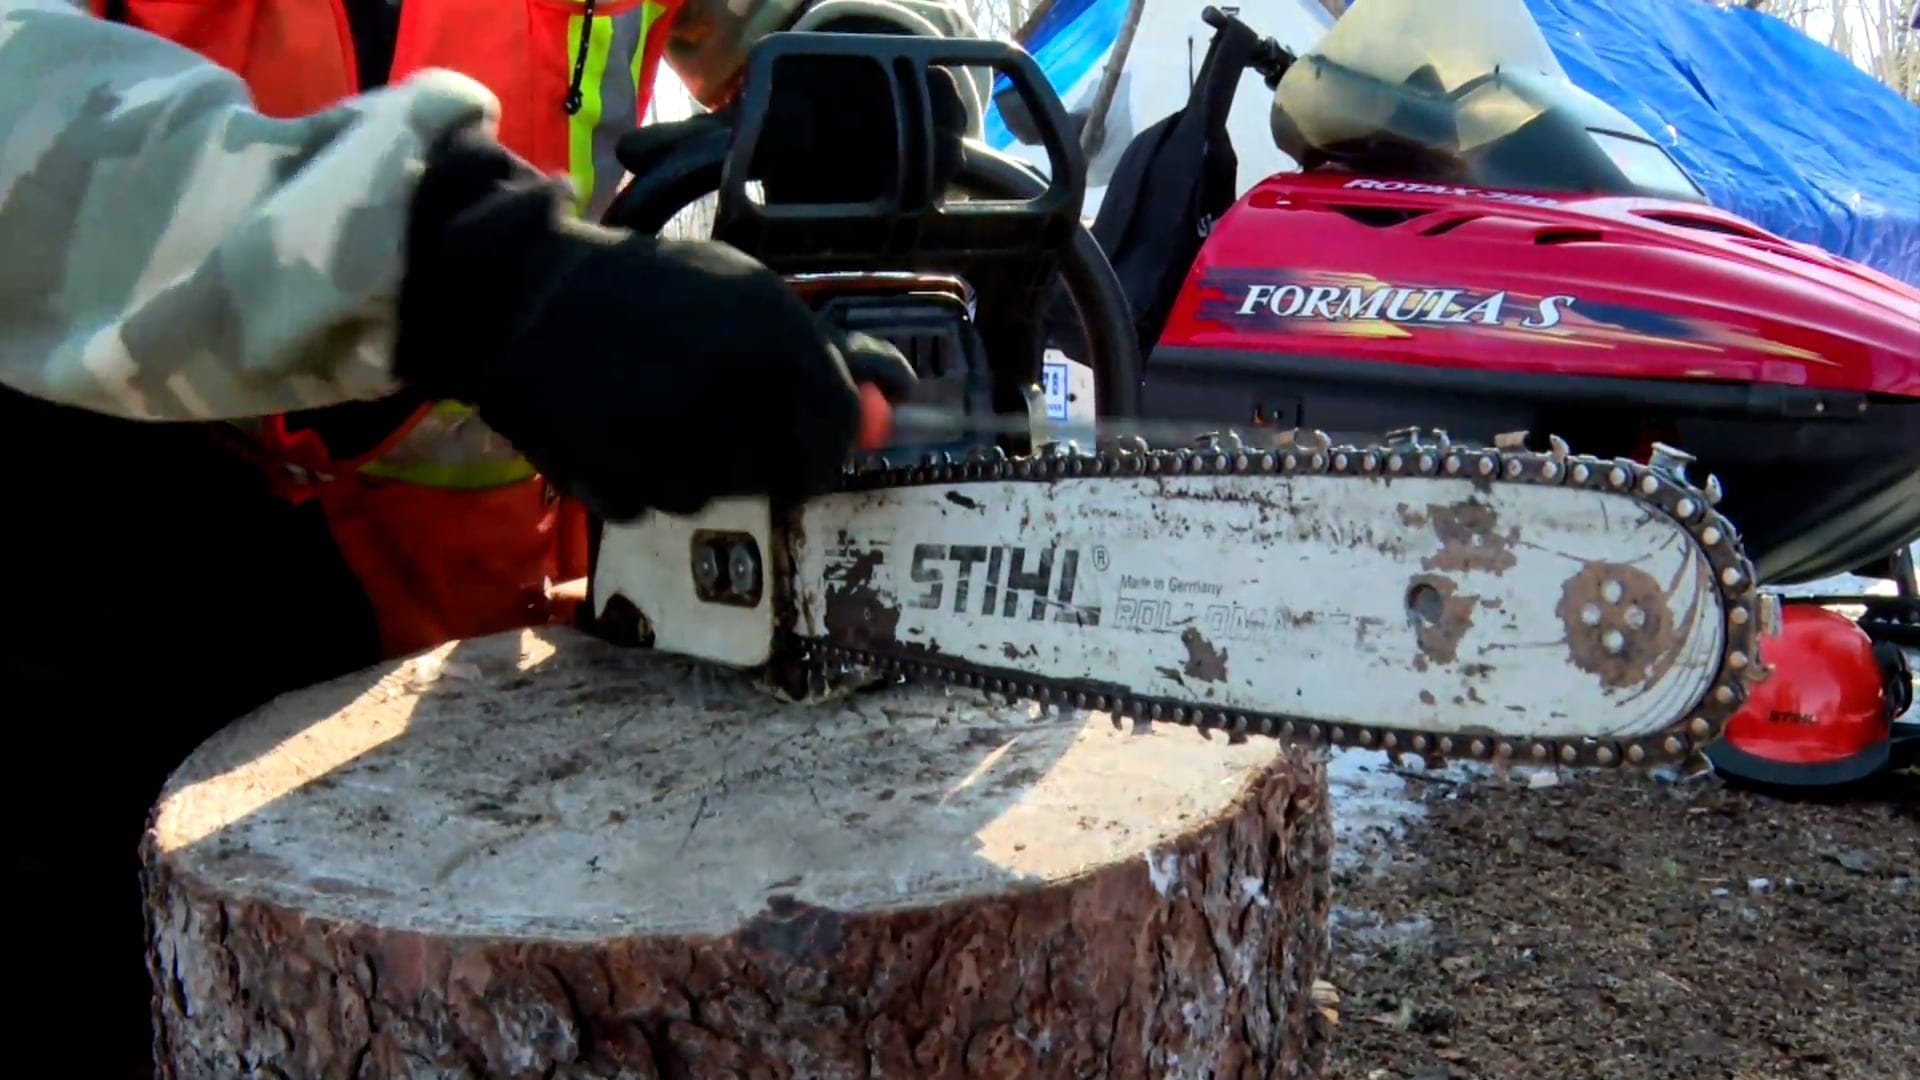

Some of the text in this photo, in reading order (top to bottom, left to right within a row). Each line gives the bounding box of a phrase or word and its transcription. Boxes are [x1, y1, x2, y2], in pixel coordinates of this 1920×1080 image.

[1343, 179, 1479, 196] ROTAX
[1236, 284, 1576, 329] FORMULA S
[910, 543, 1101, 627] STIHL
[1119, 574, 1151, 590] Made
[1168, 577, 1223, 596] Germany
[1768, 711, 1817, 724] STIHL
